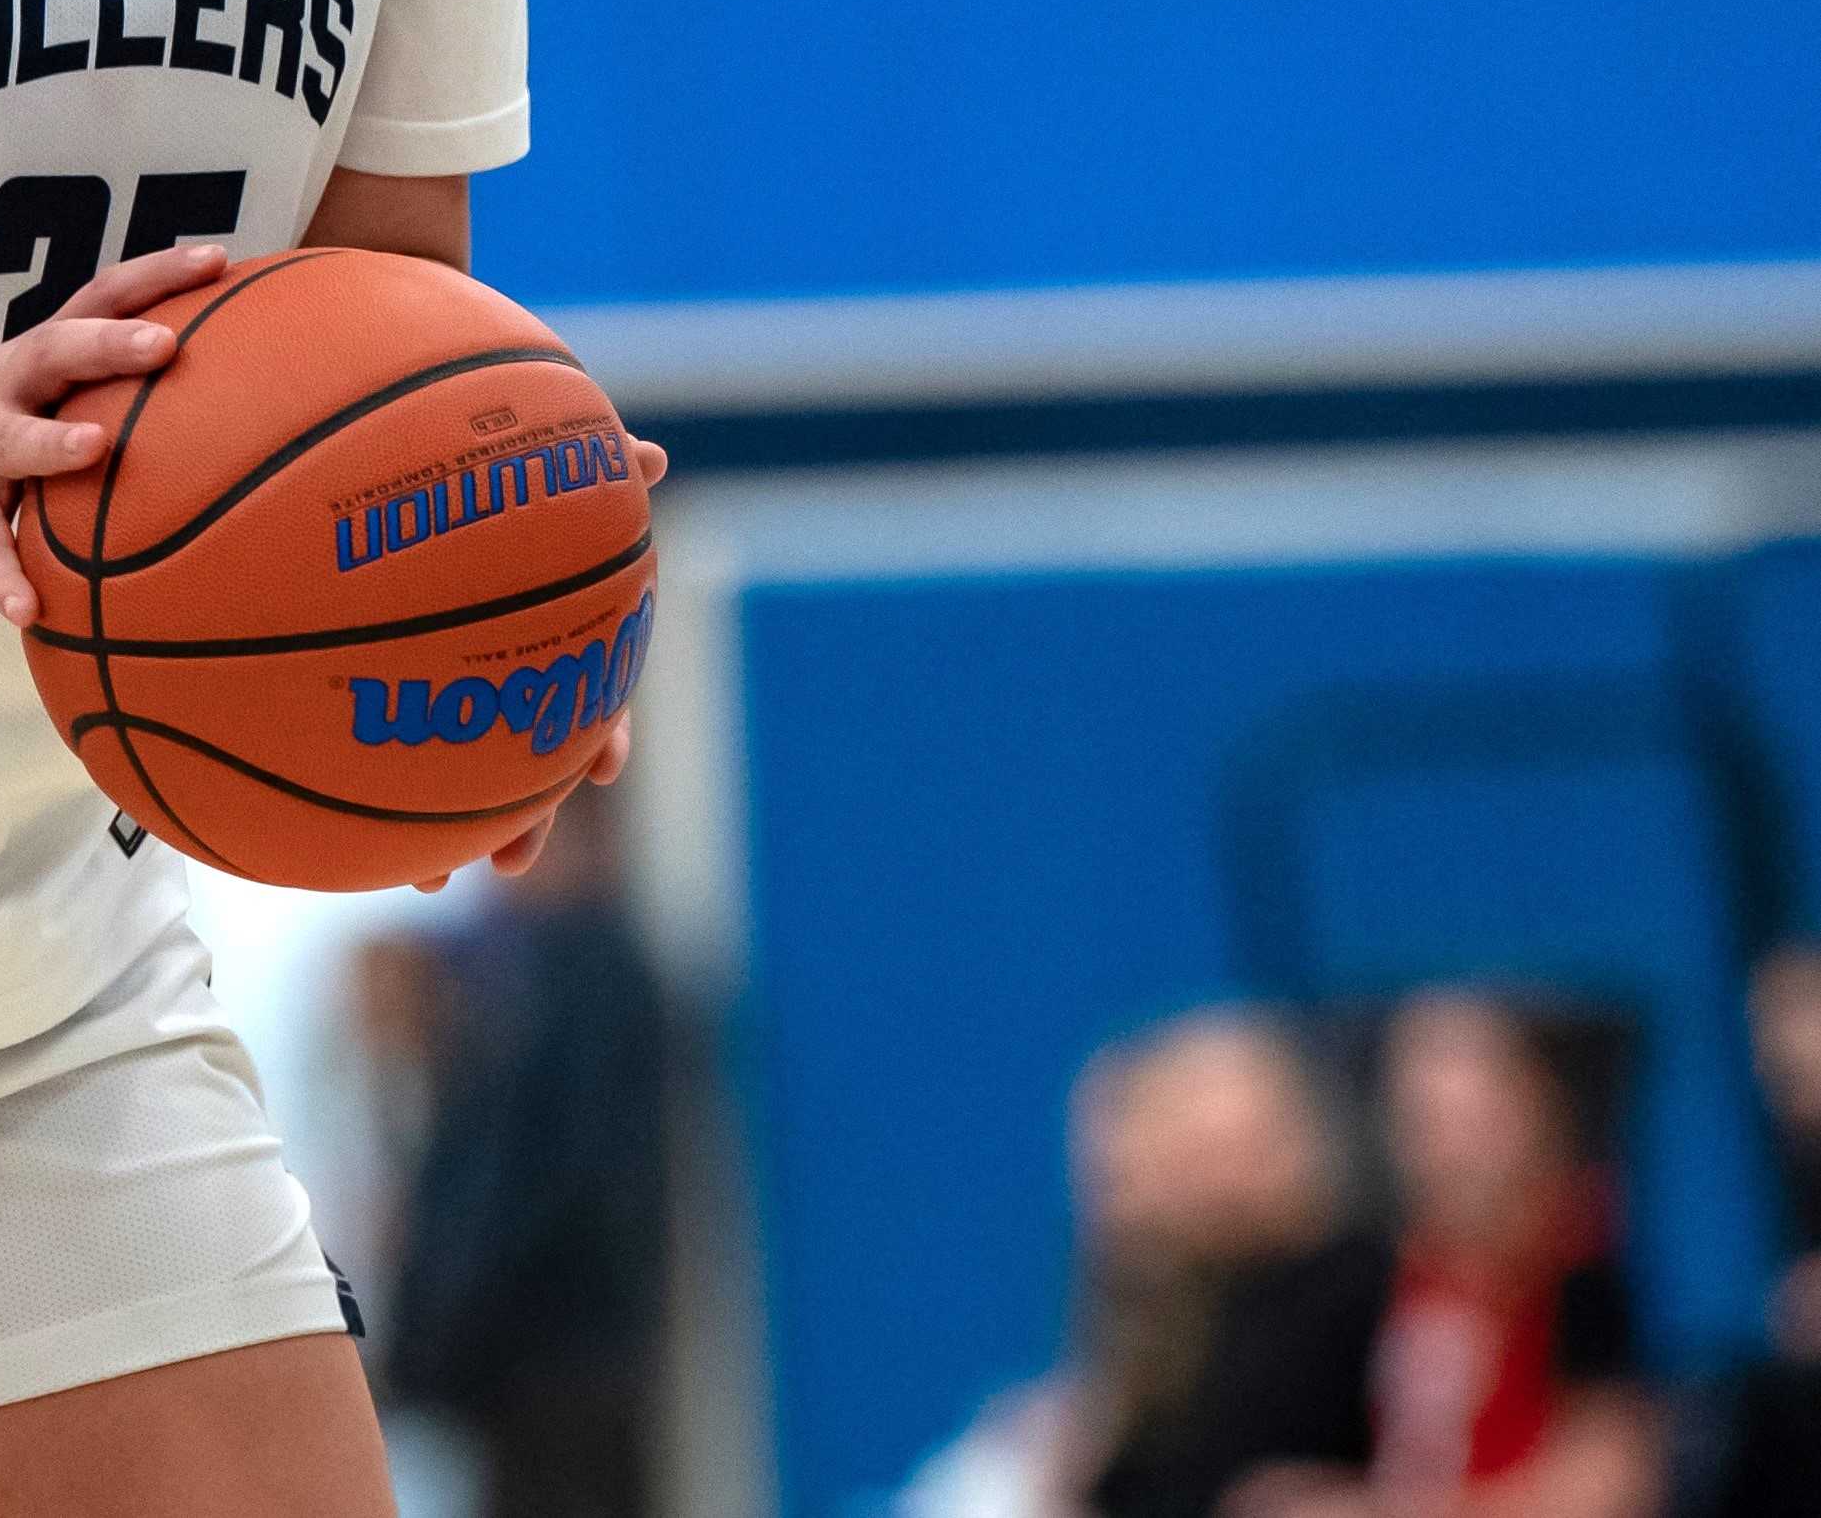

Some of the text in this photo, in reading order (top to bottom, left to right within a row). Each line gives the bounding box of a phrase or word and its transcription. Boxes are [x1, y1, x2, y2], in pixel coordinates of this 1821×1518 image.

[335, 431, 629, 573] EVOLUTION
[348, 589, 653, 756] Wilson
[461, 649, 508, 664] BALL
[515, 634, 562, 657] GAME
